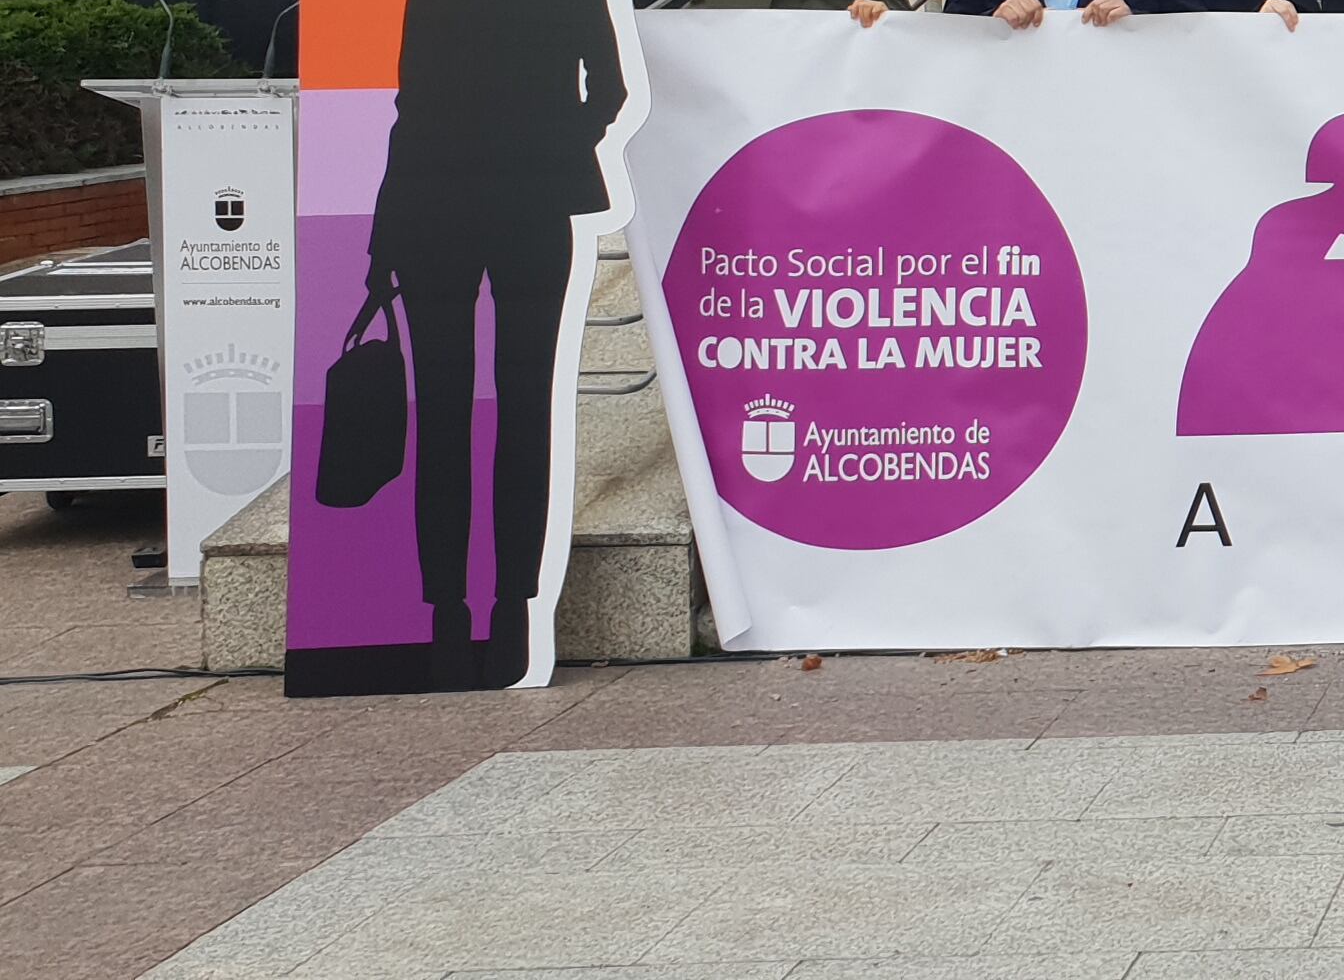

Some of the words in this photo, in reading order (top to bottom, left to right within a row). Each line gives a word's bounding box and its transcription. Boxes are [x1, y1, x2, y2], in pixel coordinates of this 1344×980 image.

[180, 240, 260, 256] Ayuntamiento
[266, 239, 279, 251] de
[181, 256, 280, 270] ALCOBENDAS
[702, 248, 777, 276] Pacto
[788, 247, 882, 276] Social
[897, 255, 951, 284] por
[962, 246, 988, 275] el
[997, 246, 1040, 275] fin
[183, 297, 280, 308] www.alcobendas.org
[700, 288, 731, 317] de
[742, 289, 763, 318] la
[774, 287, 1036, 328] VIOLENCIA
[698, 337, 847, 369] CONTRA
[858, 338, 905, 369] LA
[915, 337, 1042, 368] MUJER
[804, 422, 955, 453] Ayuntamiento
[965, 419, 989, 443] de
[803, 452, 989, 482] ALCOBENDAS
